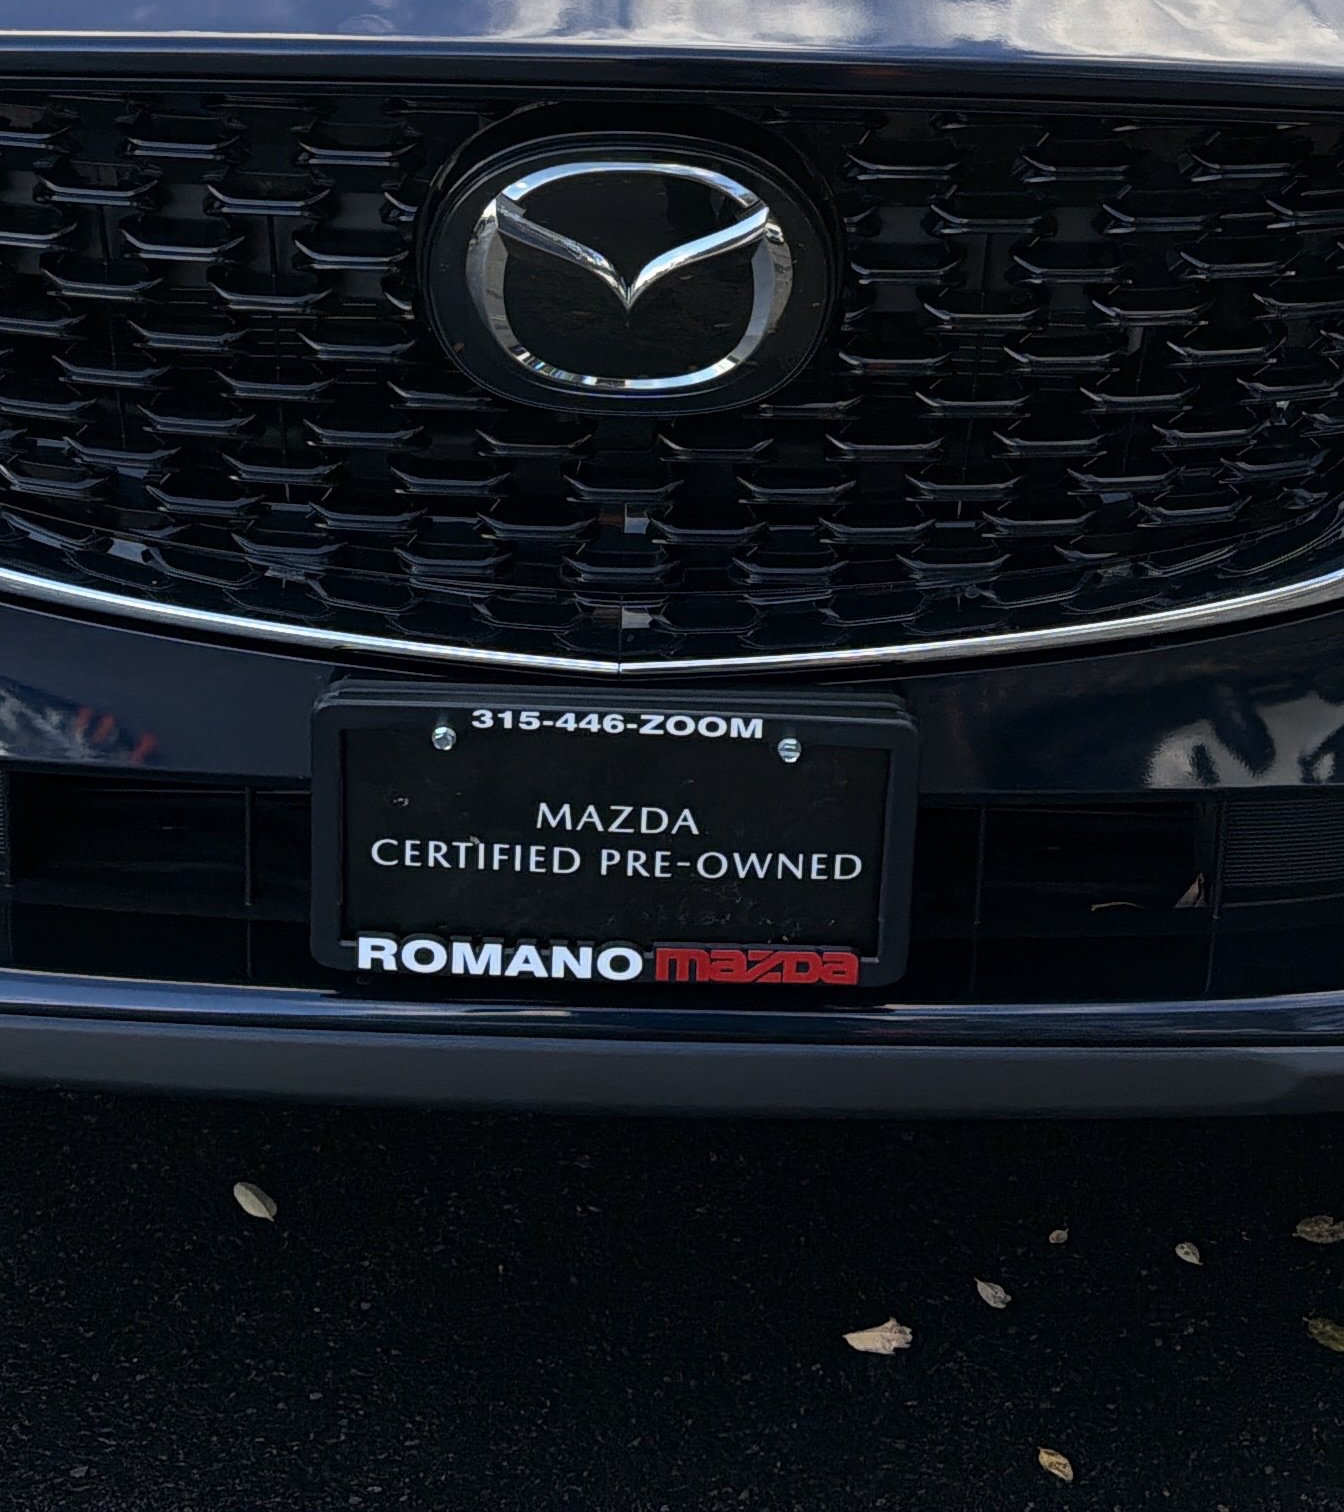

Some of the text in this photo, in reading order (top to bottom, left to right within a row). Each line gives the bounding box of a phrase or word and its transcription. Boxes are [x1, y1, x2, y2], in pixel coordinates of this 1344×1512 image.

[471, 709, 764, 739] 315-446-ZOOM
[536, 802, 699, 835] MAZDA
[370, 838, 862, 880] CERTIFIED PRE-OWNED
[357, 936, 643, 981] ROMANO
